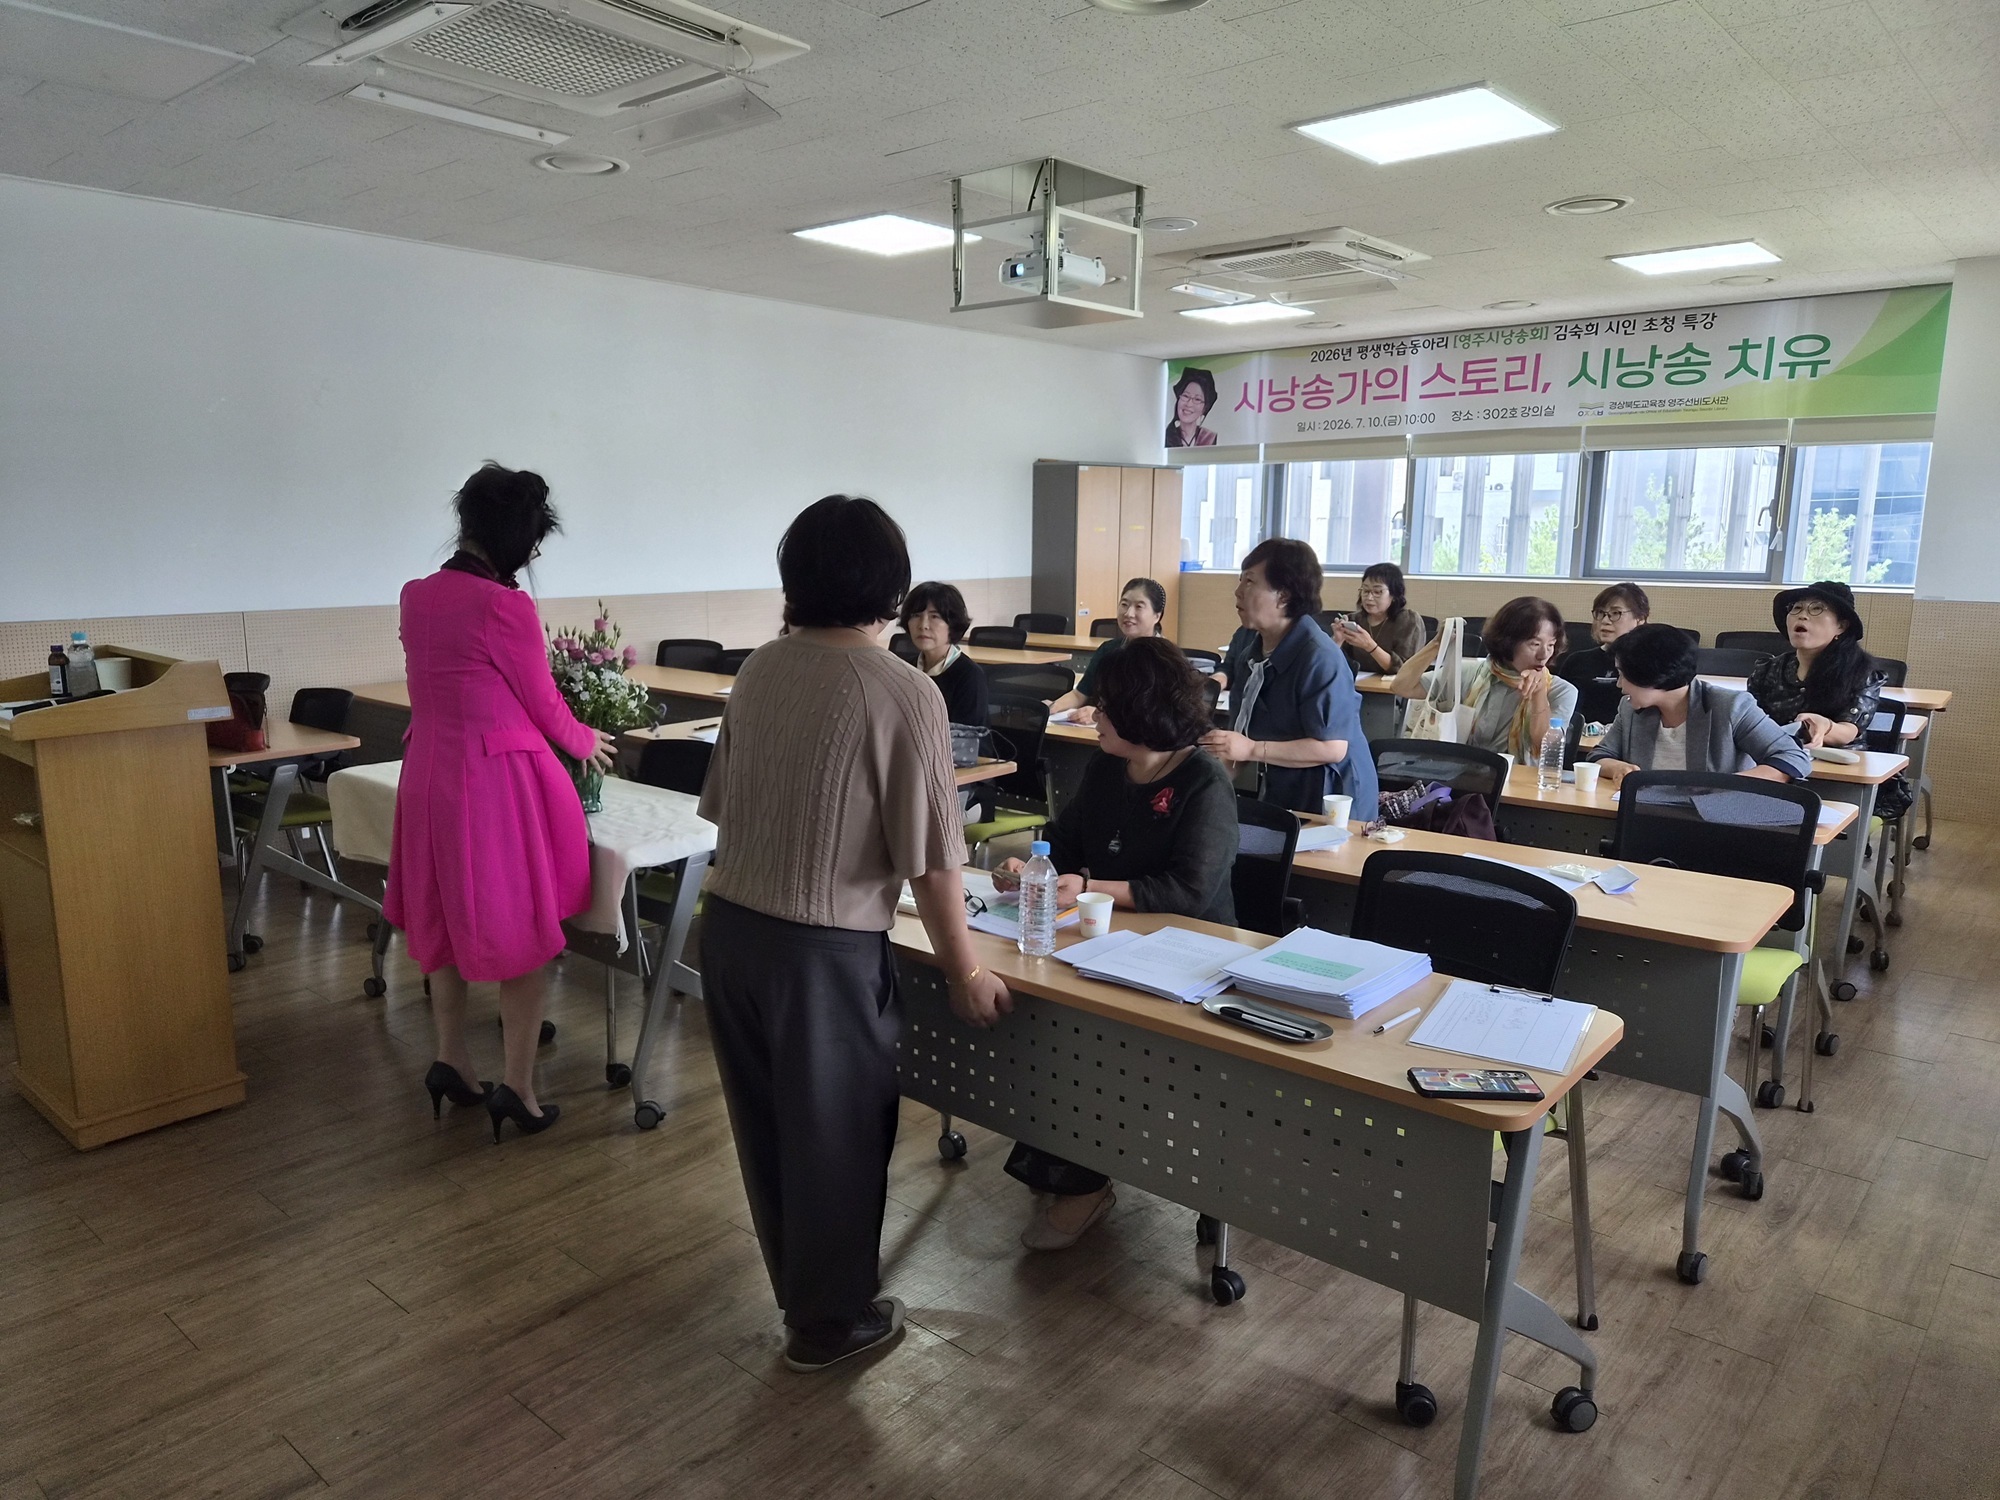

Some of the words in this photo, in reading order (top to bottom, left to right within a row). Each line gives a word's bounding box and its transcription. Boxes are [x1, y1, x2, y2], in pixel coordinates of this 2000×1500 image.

[1310, 347, 1352, 363] 2026년
[1357, 336, 1449, 360] 평생학습동아리
[1453, 326, 1549, 349] [영주시낭송회]
[1553, 322, 1599, 341] 김숙희
[1604, 319, 1637, 336] 시인
[1642, 315, 1676, 333] 초청
[1682, 312, 1718, 330] 특강
[1233, 364, 1408, 414] 시낭송가의
[1418, 352, 1552, 401] 스토리,
[1567, 342, 1713, 390] 시낭송
[1724, 333, 1832, 381] 치유
[1667, 395, 1729, 408] 영주선비도서관
[1404, 412, 1436, 425] 10:00
